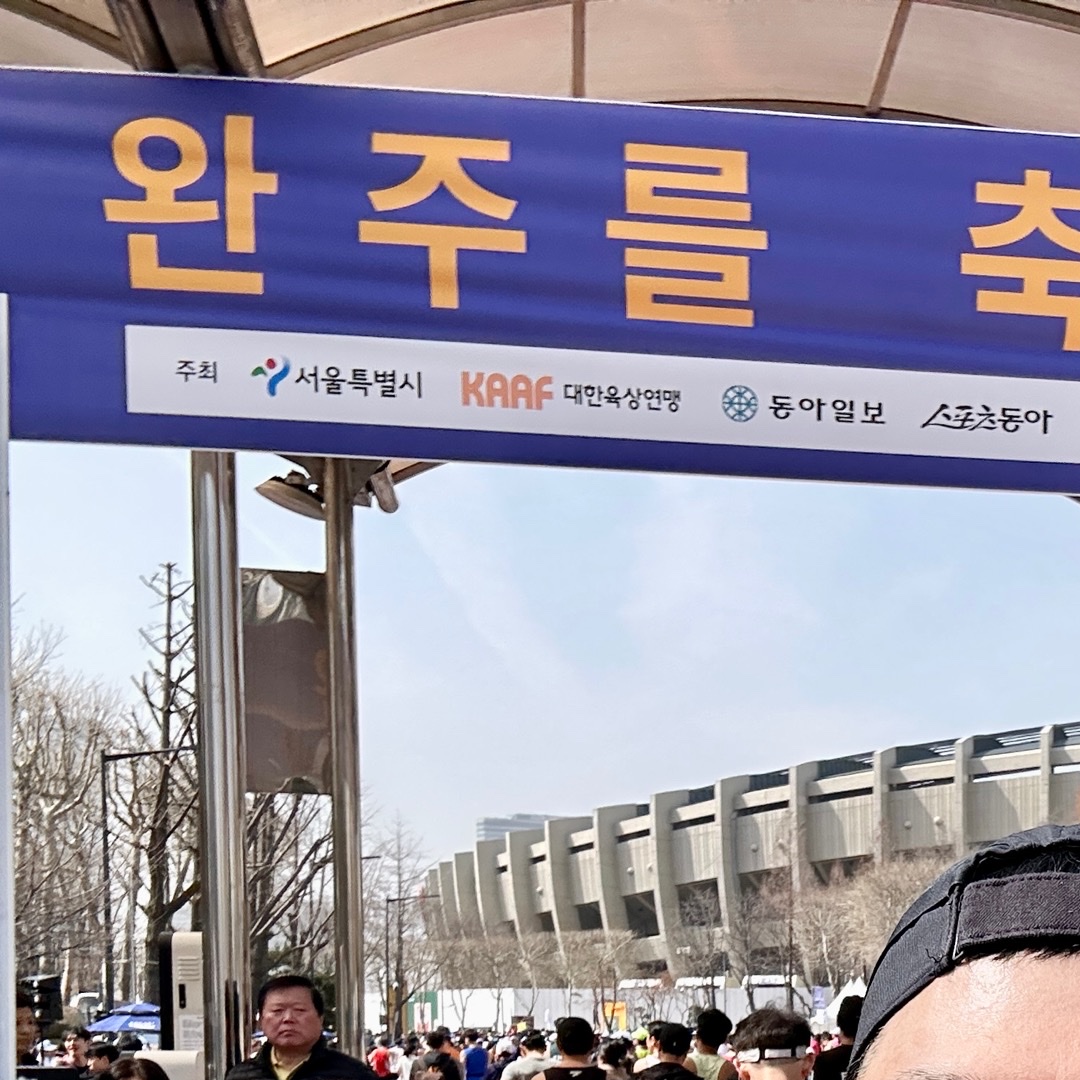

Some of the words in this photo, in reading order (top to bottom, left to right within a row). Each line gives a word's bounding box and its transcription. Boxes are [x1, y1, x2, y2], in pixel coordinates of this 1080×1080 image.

[103, 114, 768, 328] 완주를
[176, 361, 217, 384] 주최
[295, 366, 423, 398] 서울특별시
[460, 370, 553, 410] KAAF
[563, 384, 681, 412] 대한육상연맹
[769, 395, 886, 425] 동아일보
[921, 403, 1054, 434] 스포츠동아
